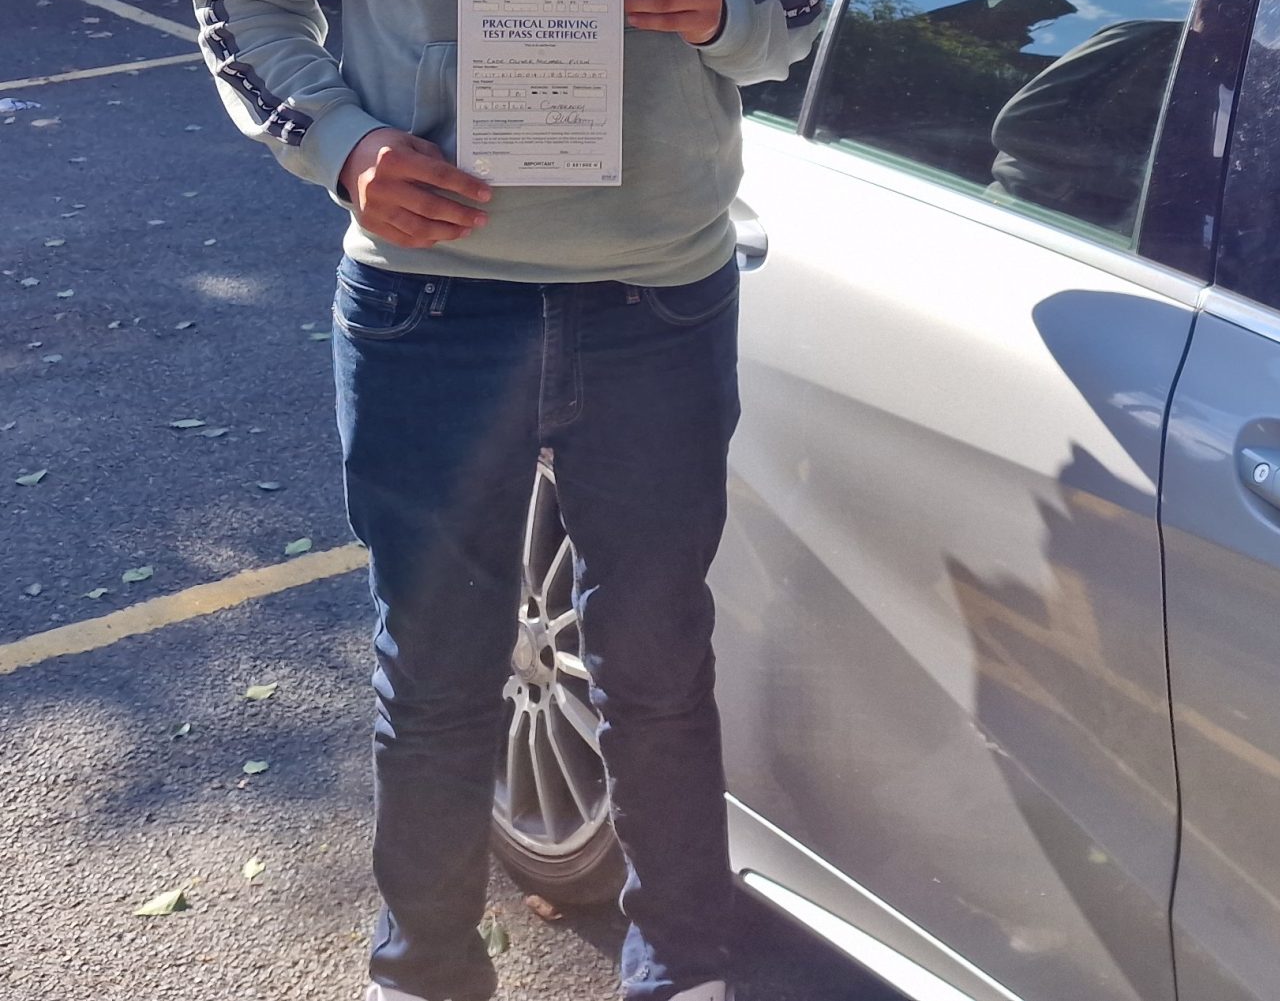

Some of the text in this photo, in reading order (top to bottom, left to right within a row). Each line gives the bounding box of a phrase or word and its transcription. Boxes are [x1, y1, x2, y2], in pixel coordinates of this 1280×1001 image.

[482, 18, 598, 30] PRACTICAL DRIVING
[483, 29, 598, 40] TEST PASS CERTIFICATE
